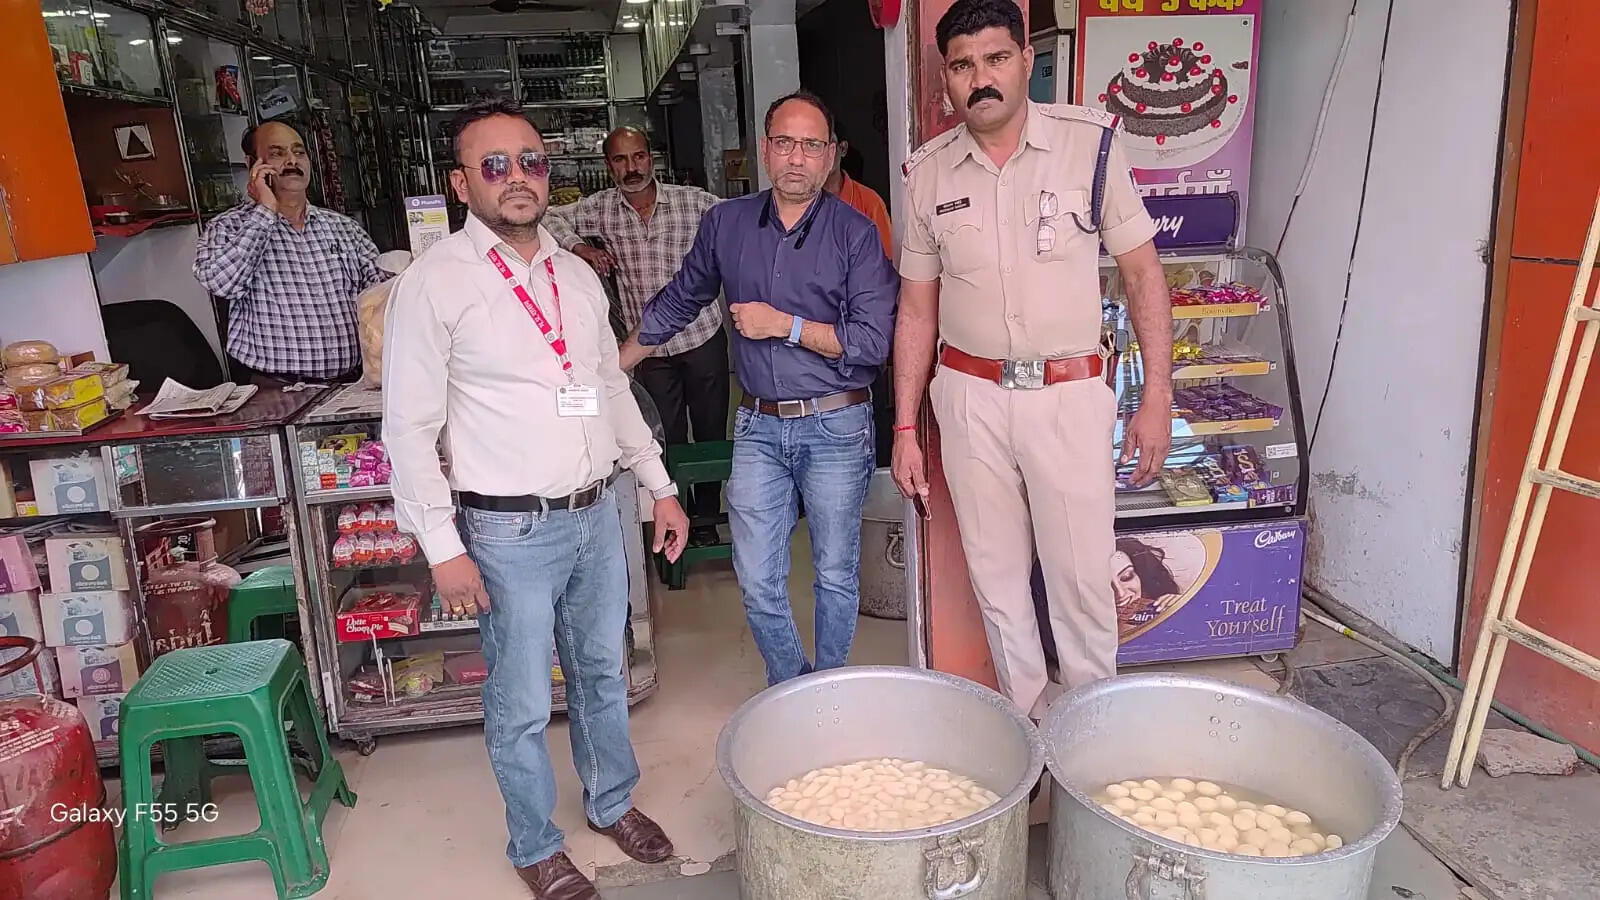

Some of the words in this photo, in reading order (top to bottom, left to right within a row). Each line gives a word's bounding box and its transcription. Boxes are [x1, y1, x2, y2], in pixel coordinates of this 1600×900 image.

[1254, 530, 1297, 548] Cadbury
[1220, 597, 1268, 616] Treat
[1204, 604, 1287, 639] Yourself
